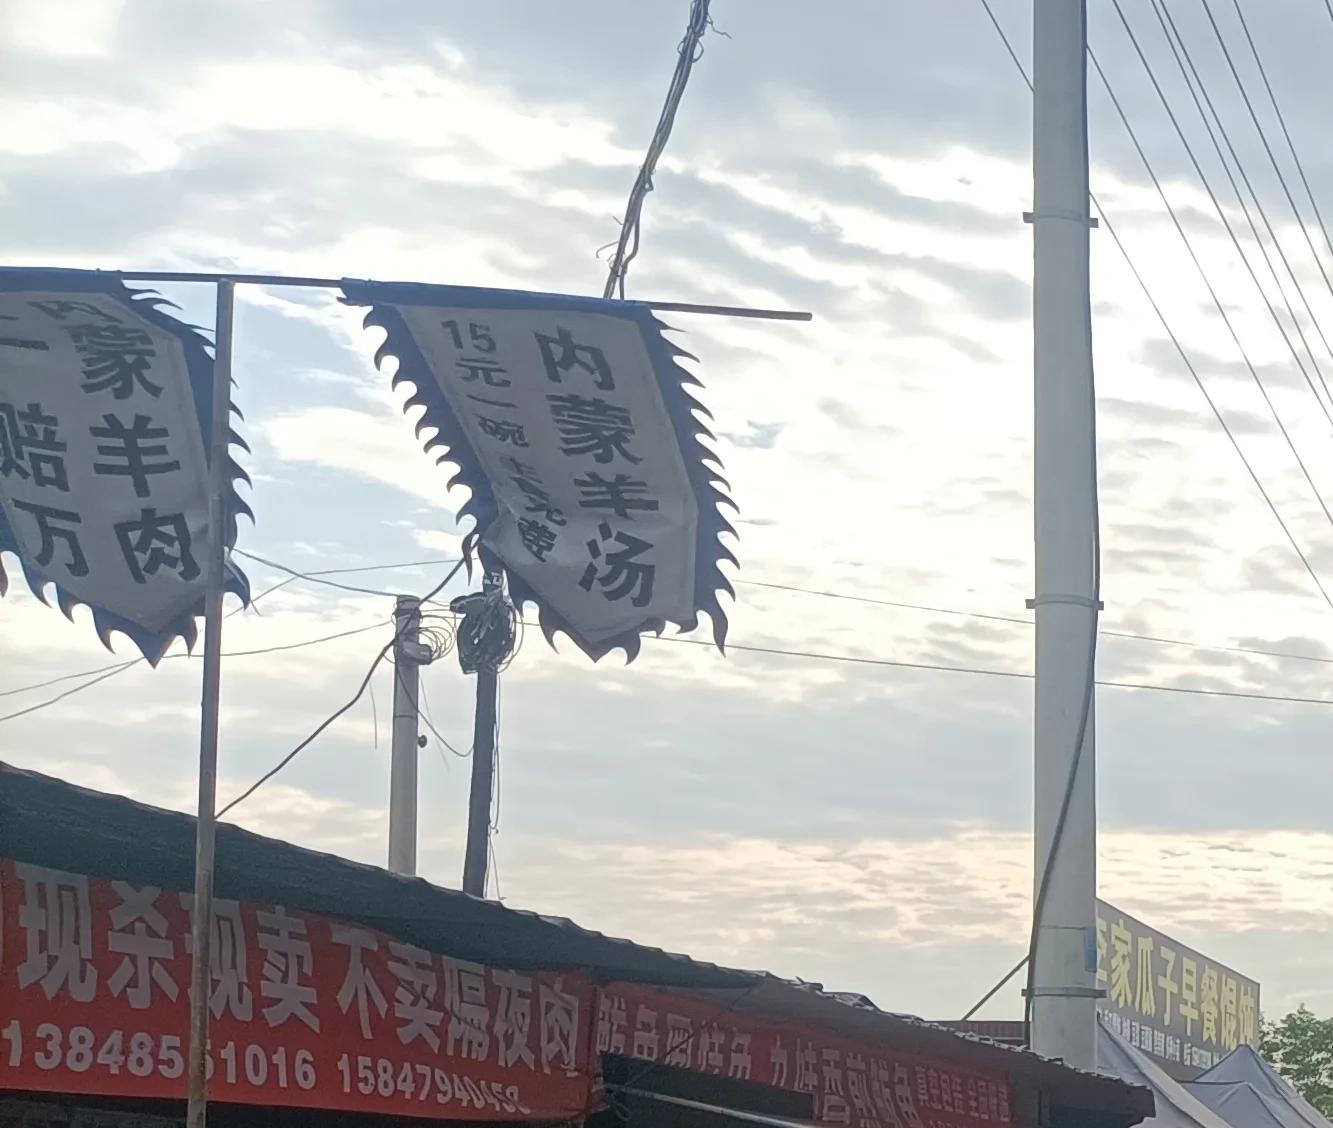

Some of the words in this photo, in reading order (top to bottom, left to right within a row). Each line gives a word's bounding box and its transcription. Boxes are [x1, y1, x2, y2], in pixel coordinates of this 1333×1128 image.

[534, 325, 658, 608] 内蒙羊汤
[15, 861, 580, 1077] 现杀现卖不卖隔夜肉
